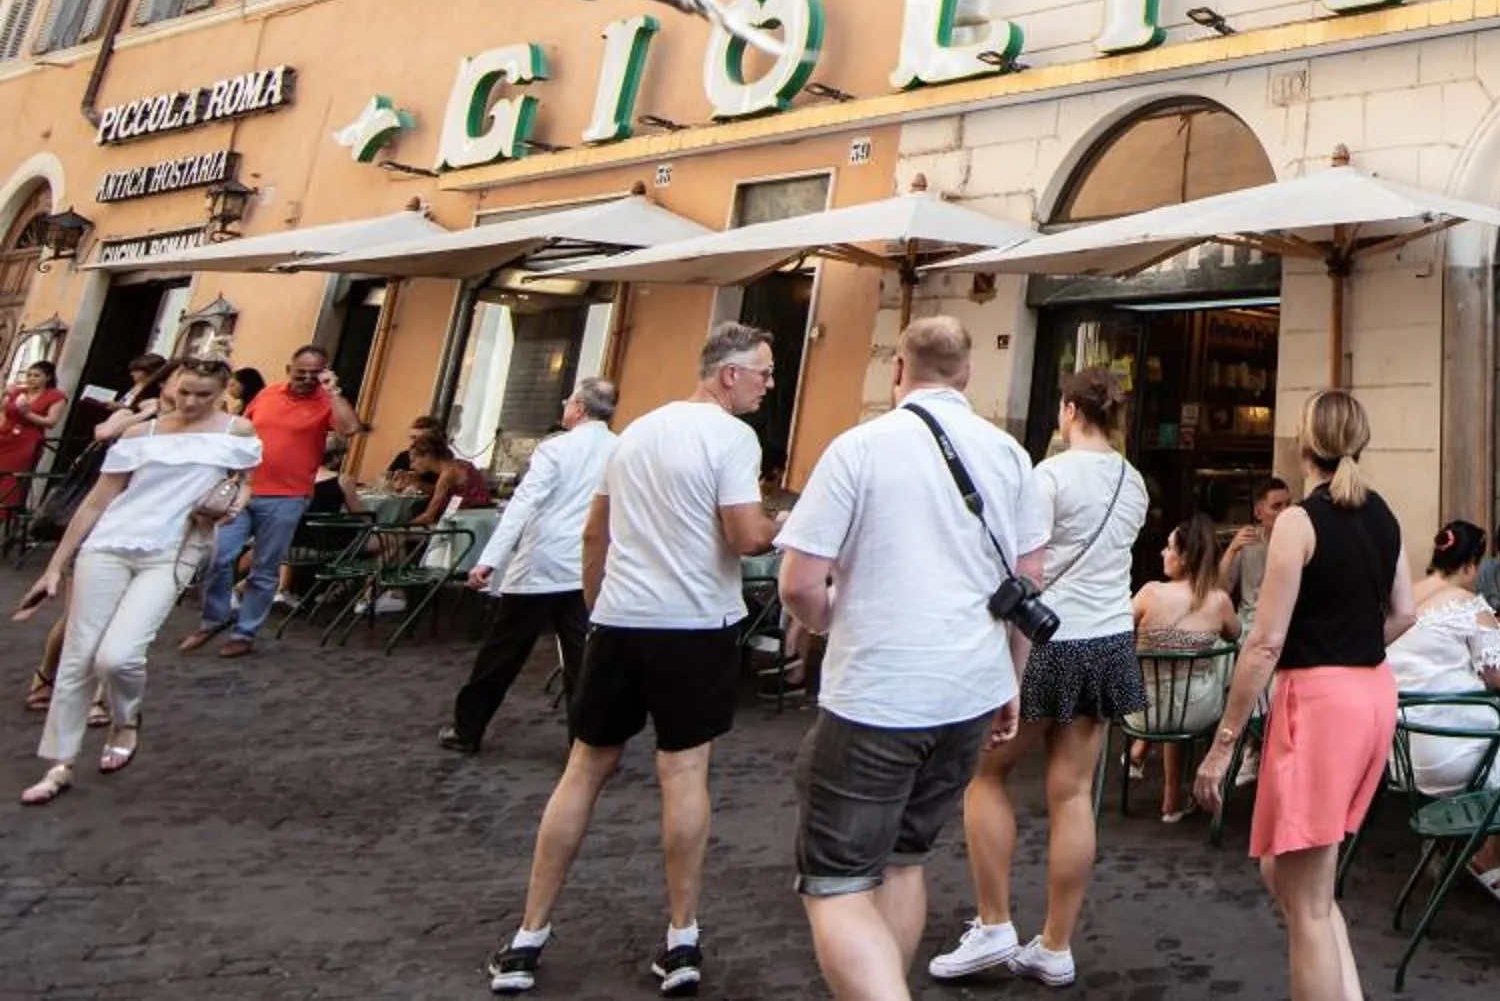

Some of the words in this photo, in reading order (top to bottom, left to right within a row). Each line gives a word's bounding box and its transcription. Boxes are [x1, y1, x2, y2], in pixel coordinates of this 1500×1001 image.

[96, 86, 200, 144] PICCOLA
[204, 64, 286, 119] ROMA
[96, 166, 148, 200] ANTICA
[149, 150, 228, 192] HOSTARIA
